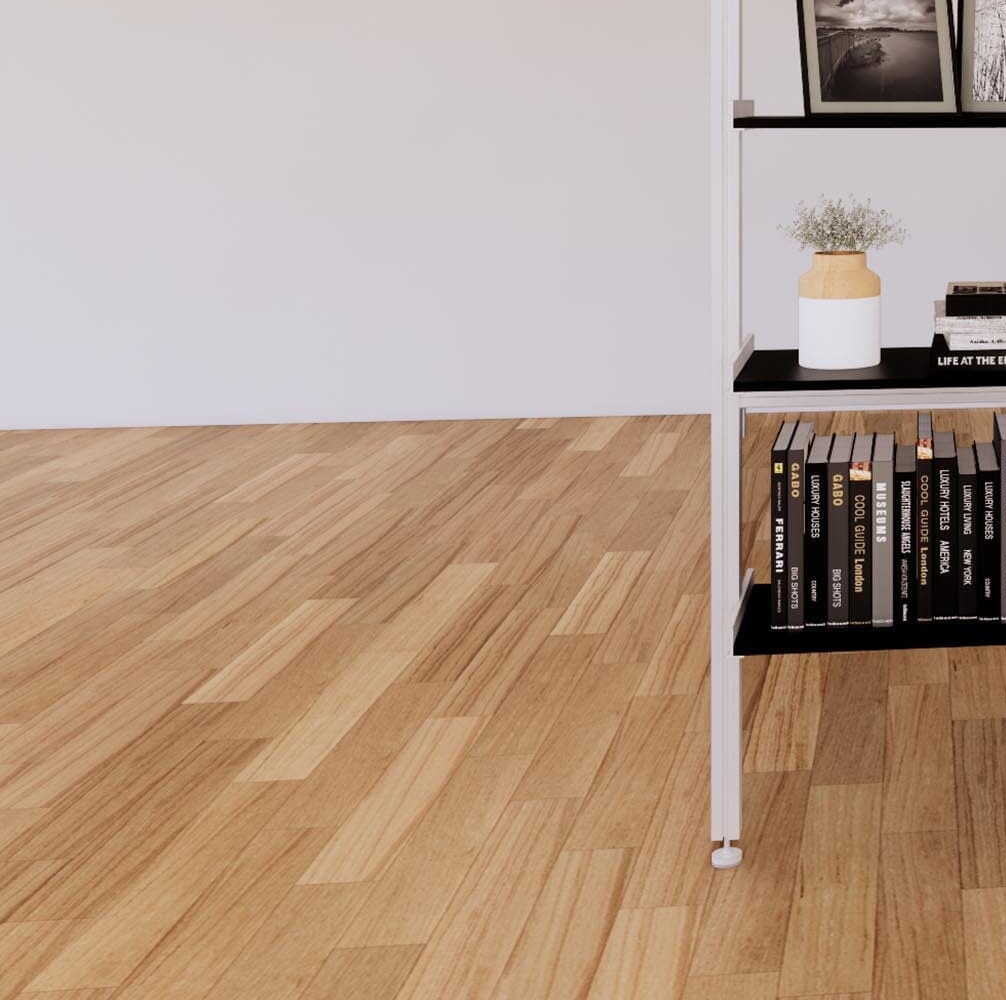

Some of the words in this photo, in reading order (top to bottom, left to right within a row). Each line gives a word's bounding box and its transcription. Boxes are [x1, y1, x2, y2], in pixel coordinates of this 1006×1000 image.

[938, 356, 958, 366] LIFE
[960, 356, 974, 366] AT
[976, 356, 996, 365] THE
[791, 463, 800, 498] GABO
[811, 475, 820, 505] LUXURY
[832, 474, 843, 506] GABO
[920, 475, 929, 505] COOL
[940, 470, 950, 499] LUXURY
[854, 495, 865, 522] COOL
[901, 481, 911, 530] SLAUGHTERHOUSE
[963, 485, 972, 511] LUXURY
[984, 482, 993, 509] LUXURY
[811, 507, 820, 538] HOUSES
[876, 482, 886, 543] MUSEUMS
[920, 510, 929, 543] GUIDE
[940, 501, 950, 530] HOTELS
[963, 513, 972, 535] LIVING
[984, 511, 993, 539] HOUSES
[775, 518, 784, 573] FERRARI
[854, 525, 865, 554] GUIDE
[901, 532, 911, 553] ANGELS
[940, 540, 950, 574] AMERICA
[963, 550, 971, 565] NEW
[832, 569, 841, 581] BIG
[854, 558, 865, 592] London
[963, 567, 971, 585] YORK
[832, 583, 841, 607] SHOTS
